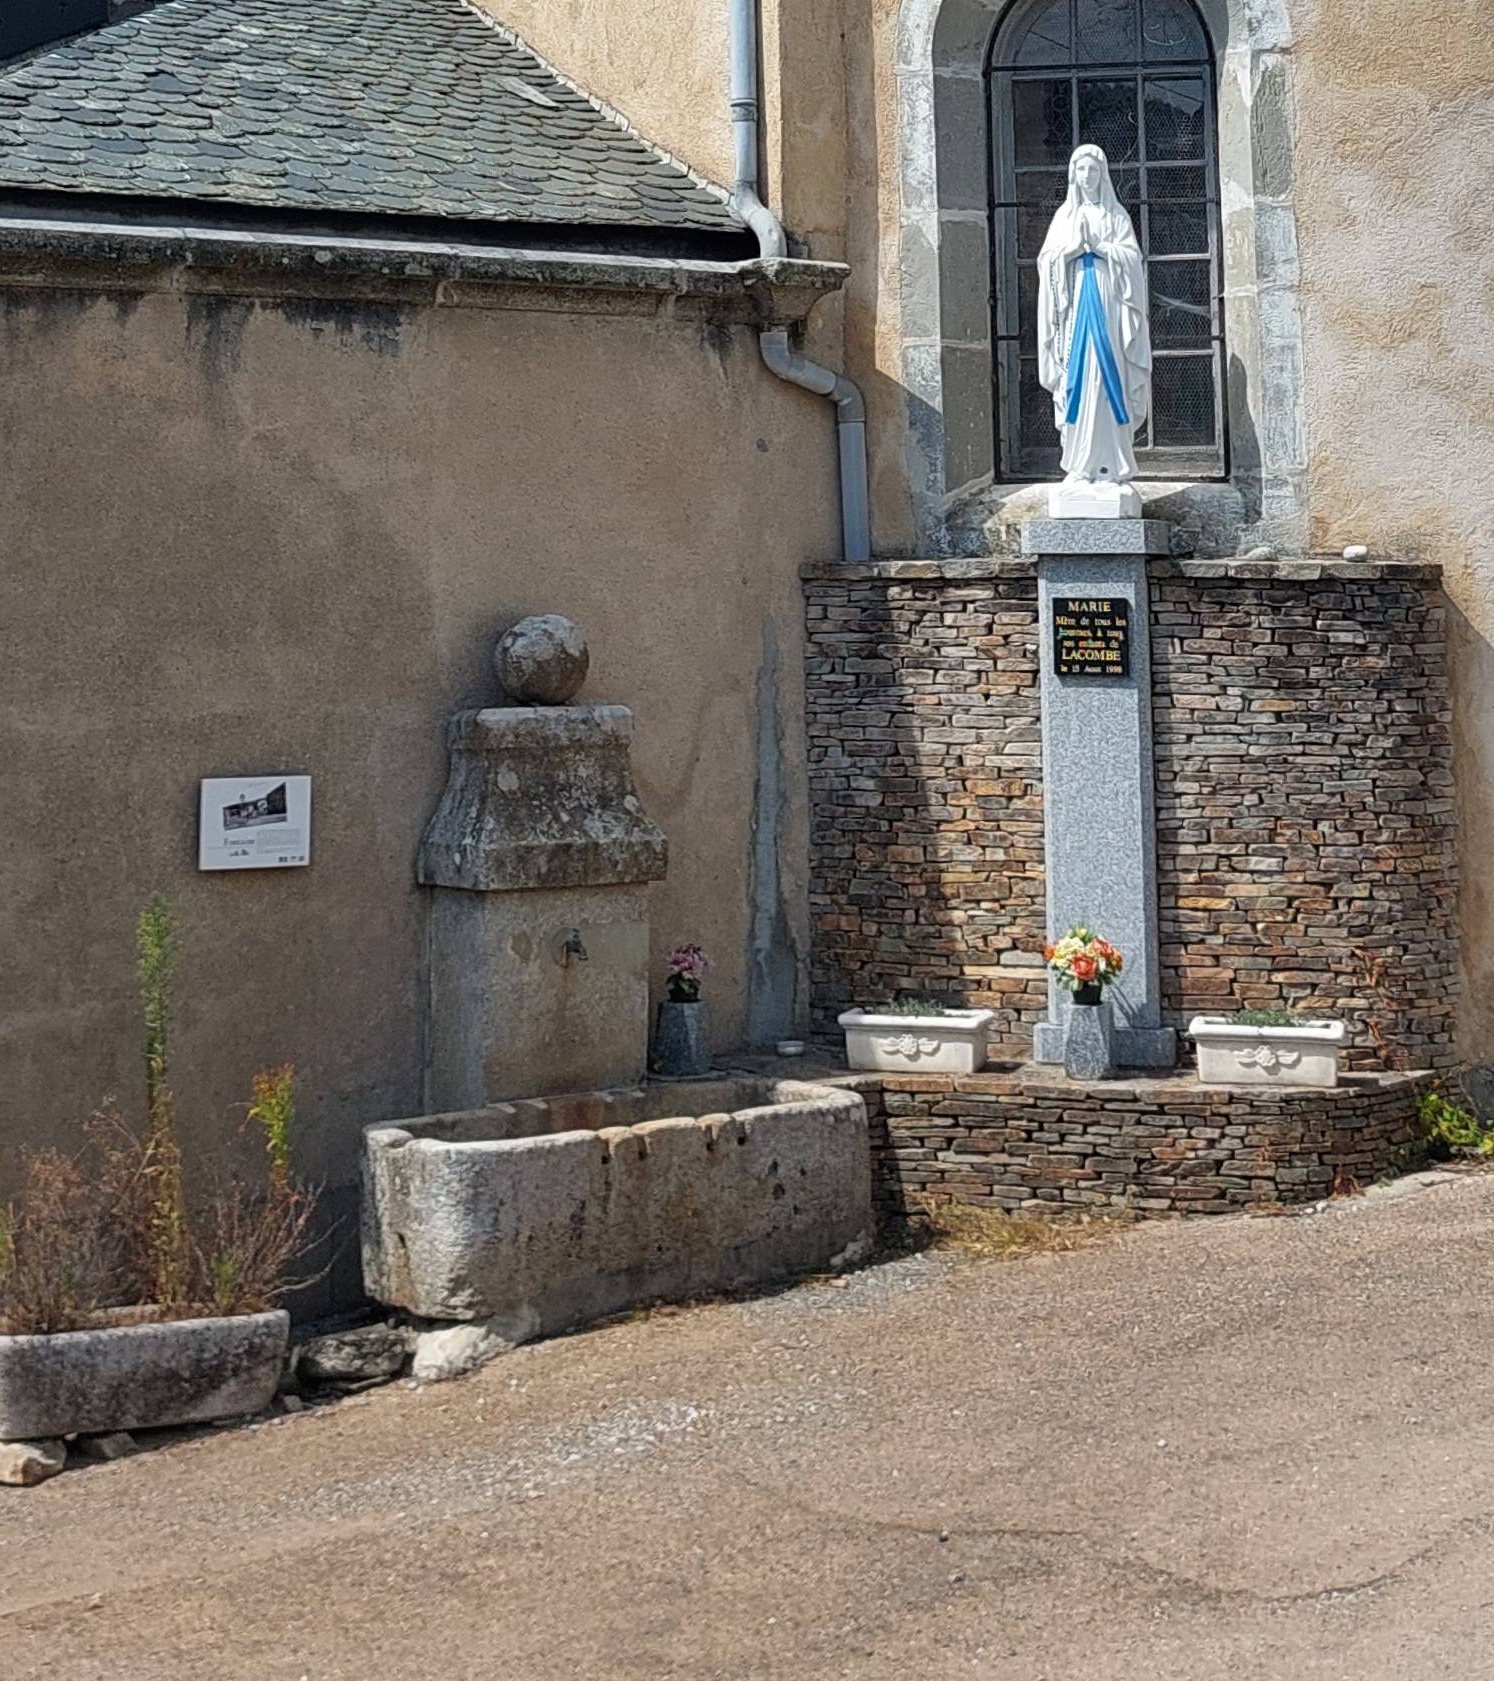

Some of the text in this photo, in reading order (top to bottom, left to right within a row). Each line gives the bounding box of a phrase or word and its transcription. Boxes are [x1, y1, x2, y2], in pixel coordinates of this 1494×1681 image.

[1068, 601, 1111, 612] MARIE
[1080, 616, 1090, 626] de
[1094, 617, 1111, 626] tous
[1109, 639, 1120, 648] de
[1061, 648, 1122, 661] LACOMBE
